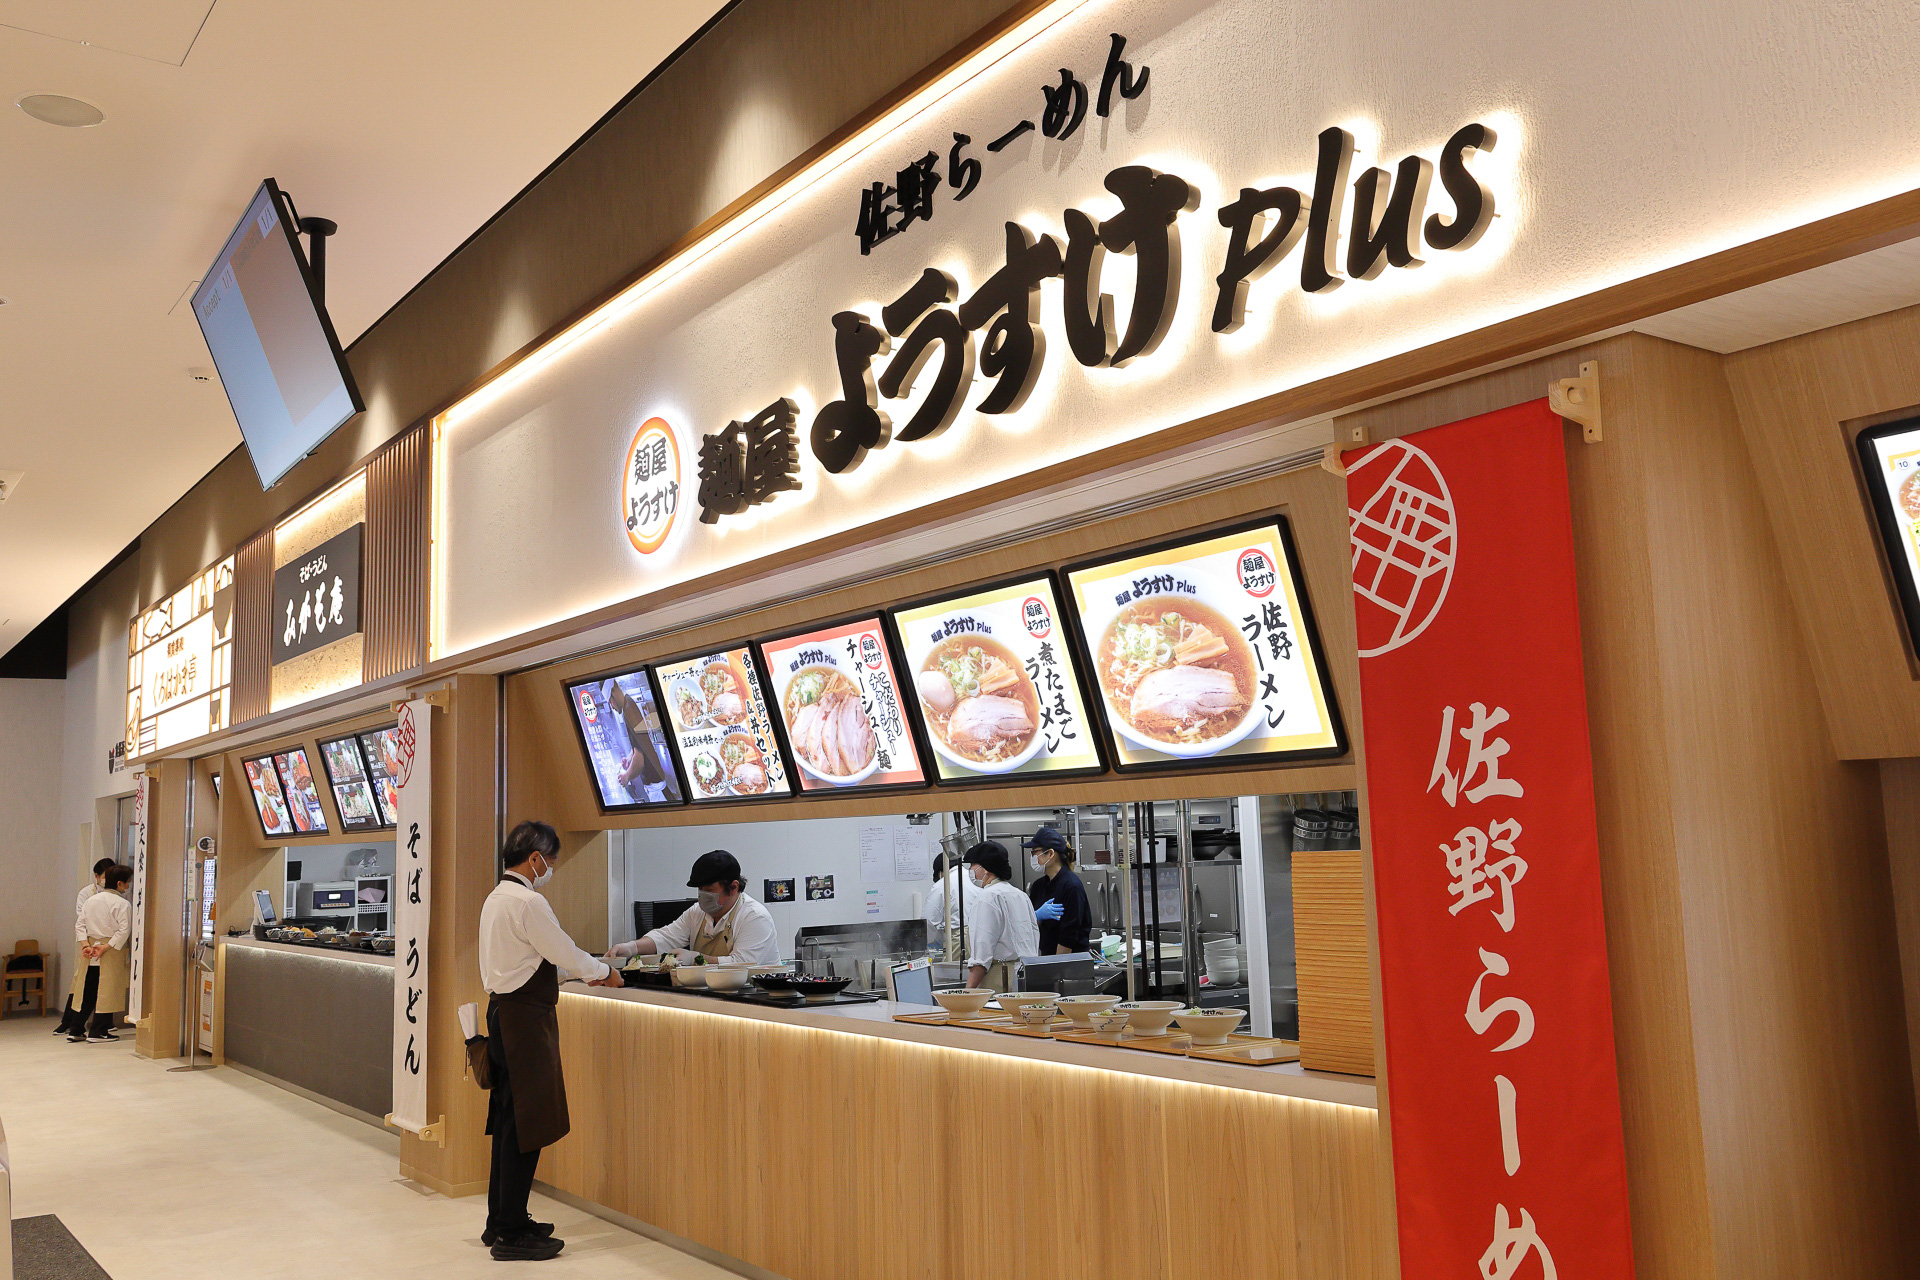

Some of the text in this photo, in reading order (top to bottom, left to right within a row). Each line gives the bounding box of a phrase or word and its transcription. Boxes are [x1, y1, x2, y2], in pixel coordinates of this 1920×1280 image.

[854, 33, 1150, 256] 佐野らーめん
[203, 288, 221, 320] Accept
[698, 398, 801, 524] 麺屋
[811, 166, 1201, 473] ようすけ
[635, 437, 667, 485] 麺屋
[626, 480, 679, 531] ようすけ
[1243, 556, 1265, 573] 麺屋
[1243, 571, 1275, 590] ようすけ
[1026, 603, 1043, 617] 麺屋
[1115, 590, 1132, 607] 麺屋
[1132, 574, 1174, 599] ようすけ
[862, 639, 876, 651] 麺屋
[943, 617, 975, 636] ようすけ
[1027, 616, 1051, 631] ようすけ
[1261, 601, 1293, 661] 佐野
[799, 650, 824, 667] ようすけ
[863, 651, 883, 663] ようすけ
[1241, 614, 1286, 729] ラーメン
[846, 639, 893, 770] チャーシュー麺
[869, 673, 897, 755] チャーシュー
[1025, 657, 1060, 753] ラーメン
[1038, 641, 1077, 739] 煮たまご
[743, 653, 784, 781] 各種佐野ラーメン
[404, 821, 423, 1075] そば うどん
